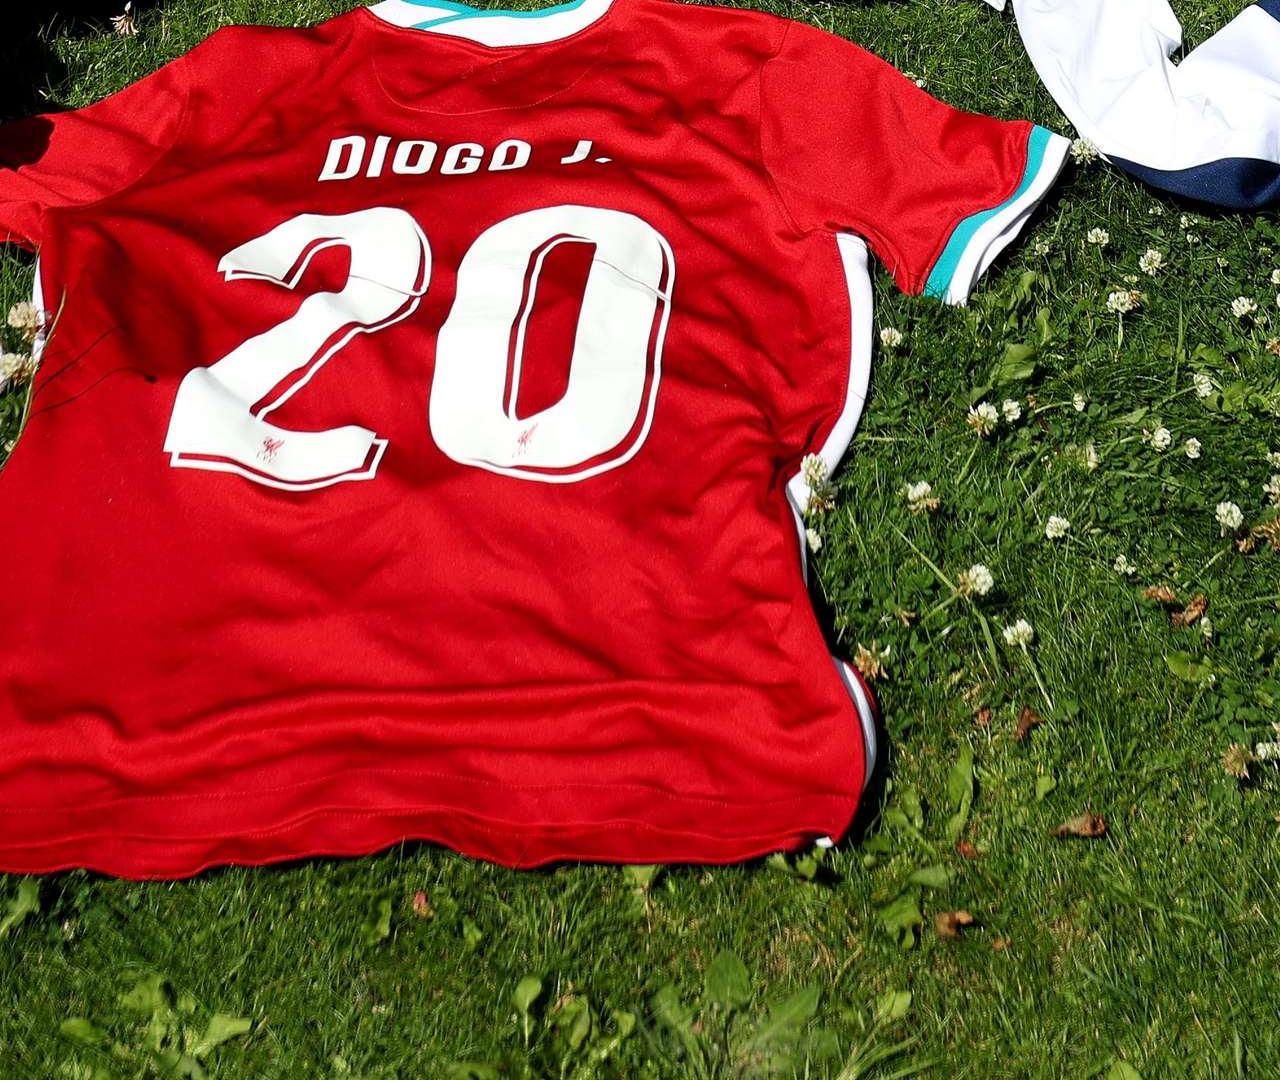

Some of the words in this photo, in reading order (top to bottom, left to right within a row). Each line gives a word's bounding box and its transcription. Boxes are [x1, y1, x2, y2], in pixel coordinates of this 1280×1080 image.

[317, 134, 532, 183] DIOGO
[560, 139, 613, 165] J.
[162, 203, 677, 493] 20
